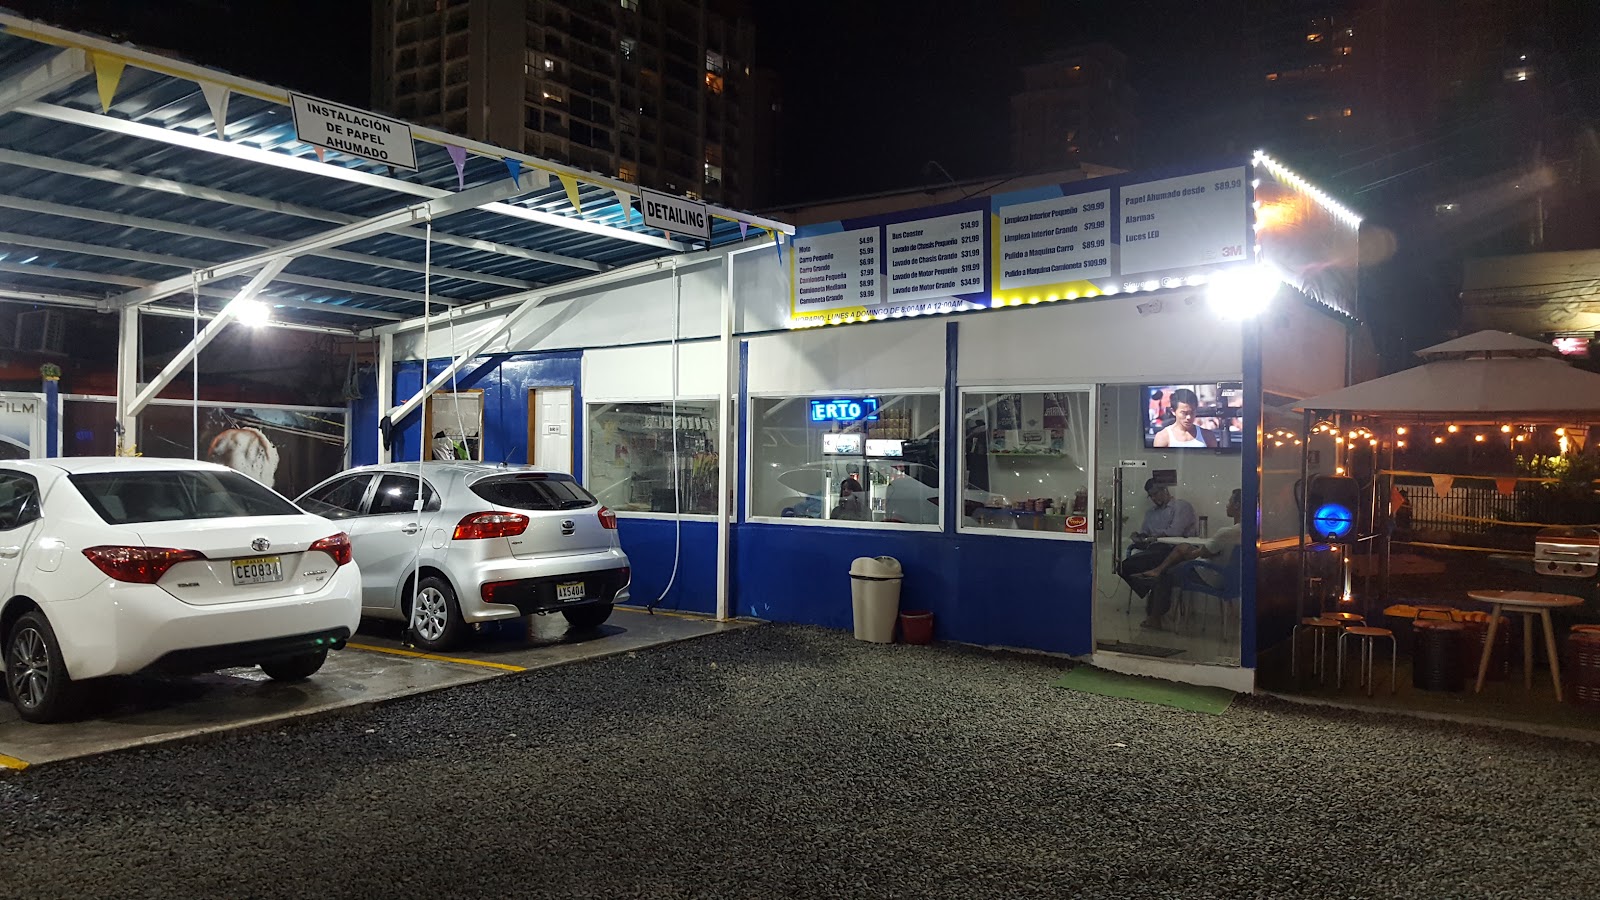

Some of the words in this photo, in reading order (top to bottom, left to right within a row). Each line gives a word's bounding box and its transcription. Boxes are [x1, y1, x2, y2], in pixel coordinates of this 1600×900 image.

[307, 102, 391, 134] INSTALACIÓN
[326, 122, 343, 135] DE
[347, 127, 385, 146] PAPEL
[326, 137, 388, 160] AHUMADO
[1125, 194, 1146, 205] Papel
[1146, 189, 1181, 202] Ahumado
[1182, 185, 1206, 197] desde
[1214, 179, 1241, 192] $89.99
[647, 201, 704, 229] DETAILING
[1004, 215, 1029, 225] Limpieza
[1029, 211, 1052, 220] Interior
[1051, 206, 1078, 218] Pequeño
[1082, 202, 1105, 212] $39.99
[1125, 213, 1155, 224] Alarmas
[892, 232, 902, 240] Bus
[960, 220, 979, 230] $14.99
[1004, 233, 1031, 243] Limpieza
[1031, 228, 1055, 238] Interior
[1055, 225, 1078, 235] Grande
[1083, 220, 1105, 231] $79.99
[1125, 231, 1147, 242] Luces
[1147, 229, 1160, 240] LED
[859, 236, 874, 244] $4.99
[892, 245, 909, 254] Lavado
[910, 243, 916, 251] de
[917, 241, 935, 250] Chasis
[961, 234, 980, 244] $21.99
[812, 252, 834, 262] Pequeño
[859, 247, 874, 255] $5.99
[892, 259, 910, 267] Lavado
[918, 255, 938, 264] Chasis
[937, 252, 958, 261] Grande
[961, 248, 980, 258] $31.99
[1004, 251, 1023, 260] Pulido
[1029, 246, 1056, 257] Maquina
[1056, 244, 1074, 253] Carro
[1082, 239, 1105, 250] $89.99
[1222, 245, 1242, 257] 3M
[799, 266, 812, 274] Carro
[812, 263, 830, 272] Grande
[860, 268, 874, 277] $7.99
[892, 272, 911, 281] Lavado
[918, 269, 934, 278] Motor
[934, 266, 958, 276] Pequeño
[961, 263, 980, 273] $19.99
[1004, 269, 1022, 278] Pulido
[1051, 261, 1082, 272] Camioneta
[1083, 257, 1107, 268] $109.99
[800, 276, 825, 284] Camioneta
[859, 279, 874, 287] $8.99
[892, 286, 911, 295] Lavado
[911, 284, 918, 292] de
[918, 282, 935, 291] Motor
[935, 281, 956, 289] Grande
[960, 277, 980, 287] $34.99
[800, 286, 825, 294] Camioneta
[825, 283, 847, 292] Mediana
[859, 290, 874, 298] $9.99
[800, 296, 825, 305] Camioneta
[825, 294, 844, 302] Grande
[827, 312, 849, 321] LUNES
[856, 307, 889, 318] DOMINGO
[889, 306, 900, 315] DE
[815, 404, 861, 418] ERTO
[236, 562, 278, 579] CE0834
